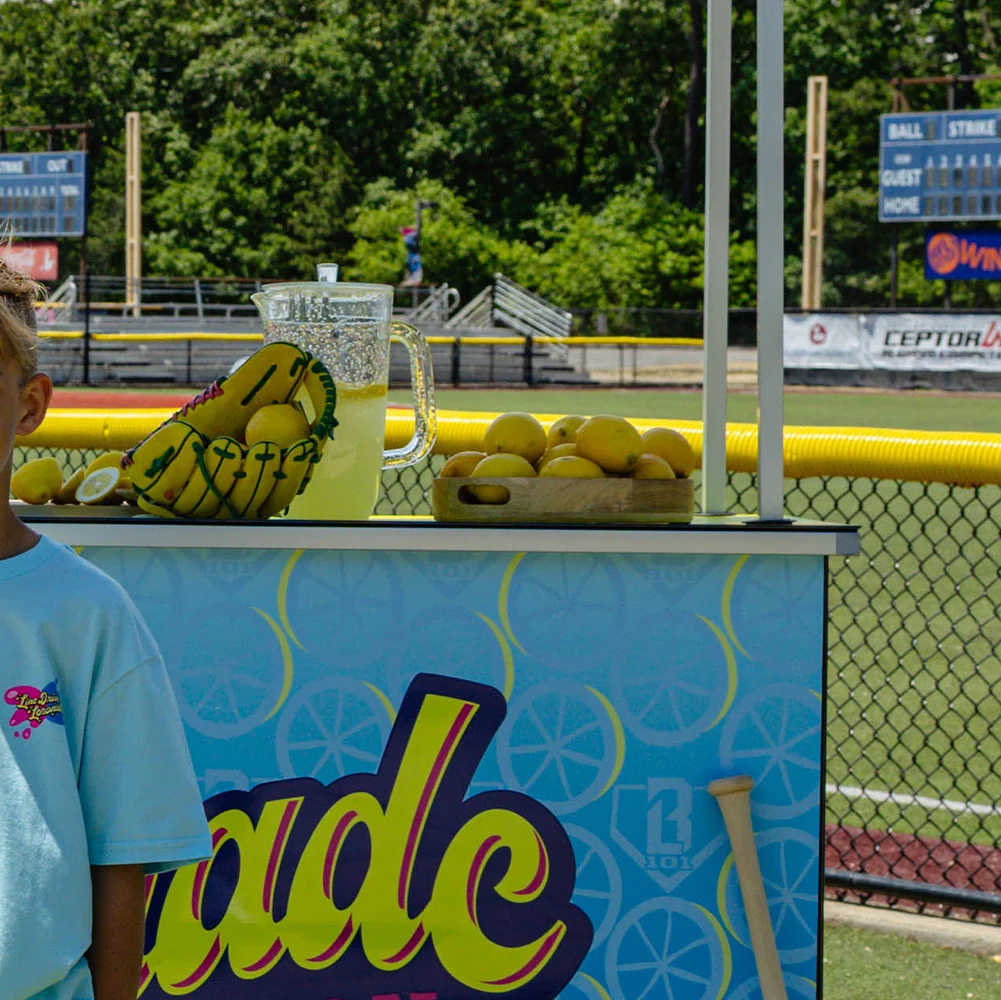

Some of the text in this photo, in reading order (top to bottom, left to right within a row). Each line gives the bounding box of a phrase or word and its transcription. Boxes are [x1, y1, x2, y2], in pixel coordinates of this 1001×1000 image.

[888, 119, 997, 140] BALL STRIKE
[47, 158, 67, 172] OUT
[881, 168, 923, 187] GUEST
[884, 196, 920, 214] HOME
